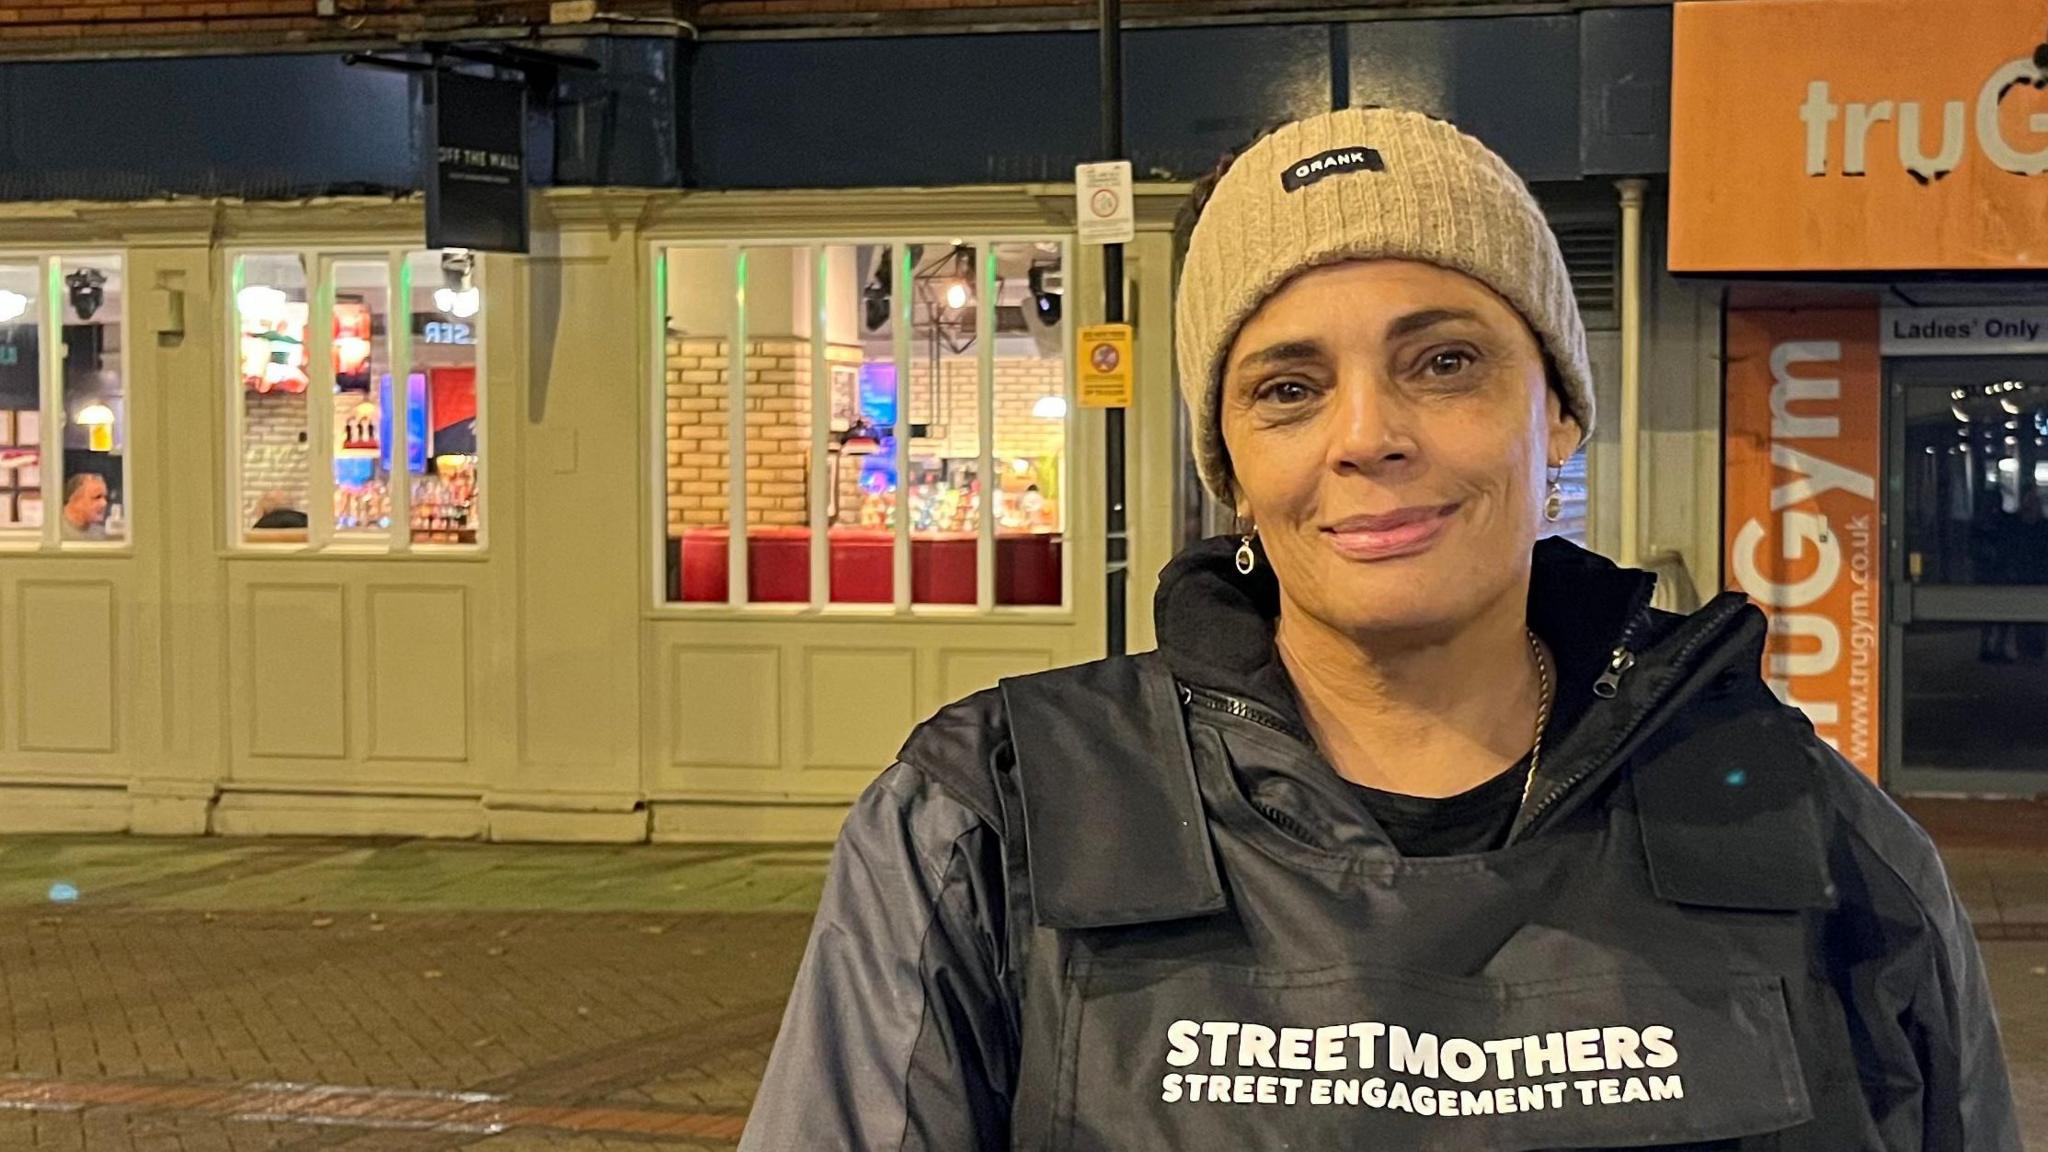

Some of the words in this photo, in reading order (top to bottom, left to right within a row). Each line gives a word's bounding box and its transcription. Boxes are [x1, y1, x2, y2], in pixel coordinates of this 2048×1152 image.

[464, 150, 486, 167] THE
[489, 153, 519, 170] WALL
[1985, 318, 2039, 341] Only
[1732, 341, 1875, 750] ruGym
[1845, 513, 1875, 759] www.trugym.co.uk
[1161, 1073, 1303, 1105] STREET
[1310, 1077, 1567, 1116] ENGAGEMENT
[1574, 1075, 1684, 1105] TEAM
